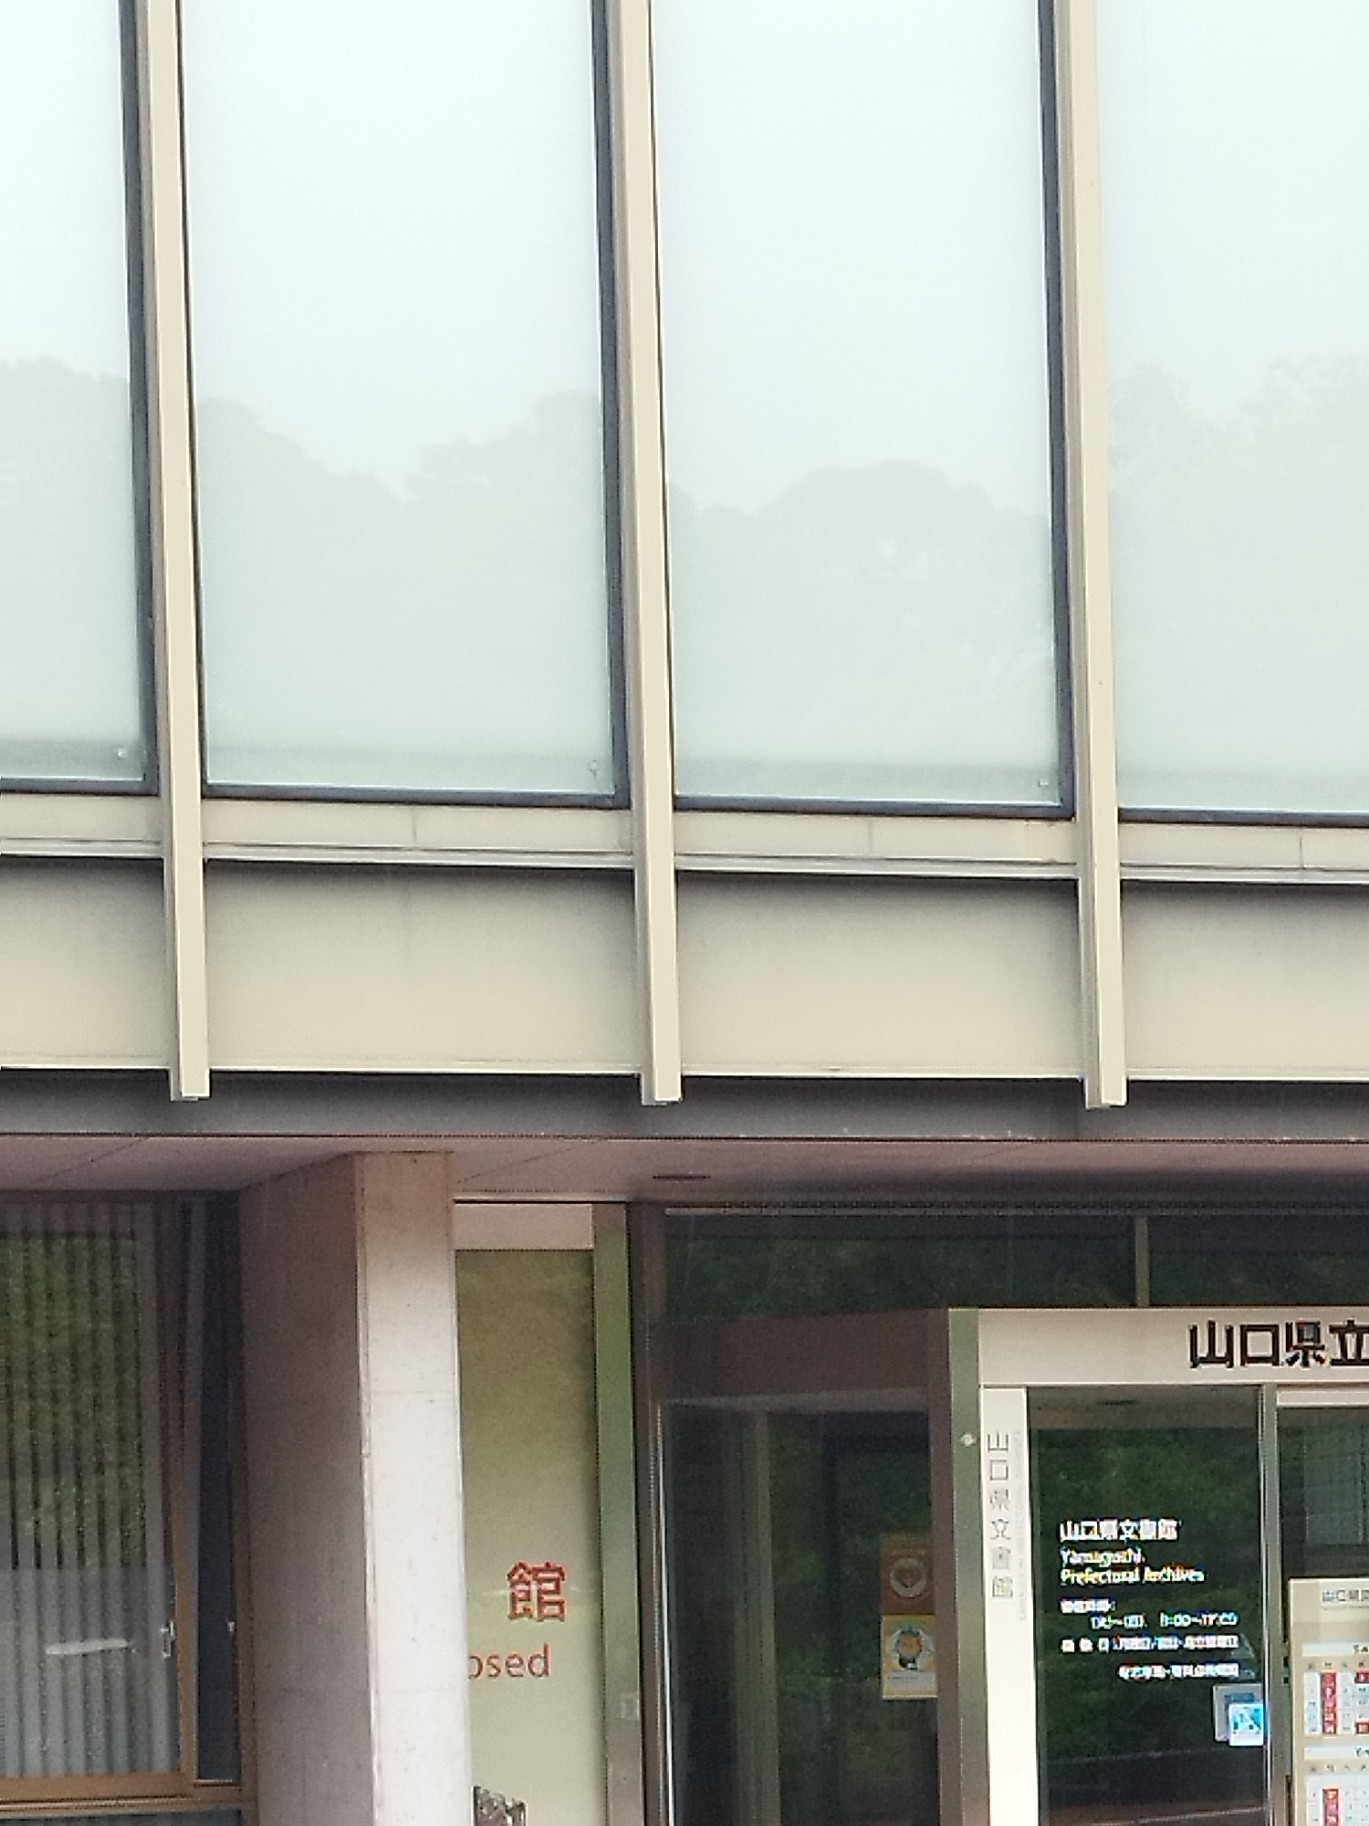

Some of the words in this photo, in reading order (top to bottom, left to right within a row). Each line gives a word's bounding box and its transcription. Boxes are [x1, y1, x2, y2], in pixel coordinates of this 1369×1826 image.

[987, 1431, 1013, 1598] 山口県文書館
[506, 1560, 566, 1622] 館
